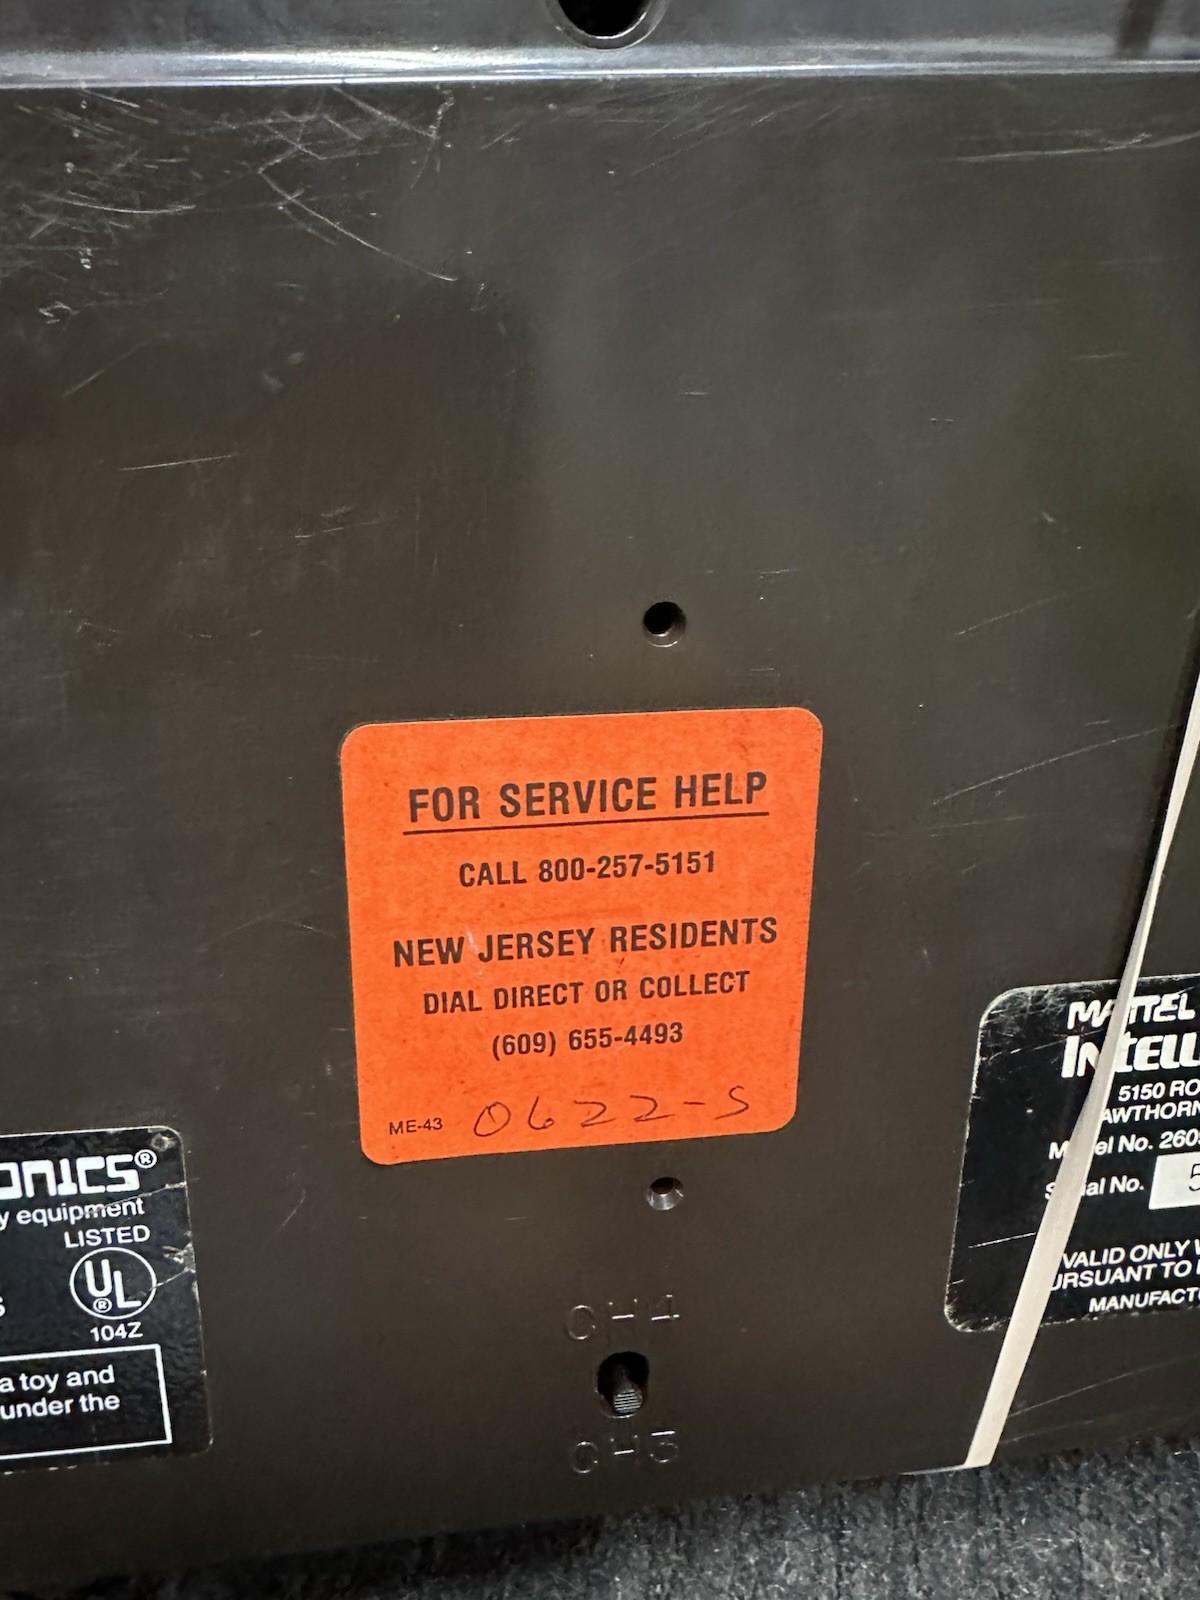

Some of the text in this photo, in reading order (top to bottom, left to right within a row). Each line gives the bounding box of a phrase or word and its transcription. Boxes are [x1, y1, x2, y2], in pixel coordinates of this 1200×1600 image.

[409, 771, 767, 823] FOR SERVICE HELP
[459, 850, 716, 887] CALL 800-257-5151
[393, 916, 778, 967] NEW JERSEY RESIDENTS
[423, 970, 750, 1014] DIAL DIRECT OR COLLECT
[492, 1021, 684, 1061] (609) 655-4493
[1118, 1081, 1166, 1101] 5150
[389, 1116, 444, 1136] ME-43
[1048, 1128, 1200, 1160] Mel No. 260
[1044, 1174, 1145, 1200] Sal No.
[15, 1197, 146, 1228] equipment
[63, 1224, 151, 1249] LISTED
[1061, 1246, 1127, 1270] VALID
[1128, 1239, 1191, 1263] ONLY
[1050, 1263, 1158, 1292] URSUANT
[1160, 1259, 1193, 1279] TO
[1088, 1286, 1200, 1313] MANUFACT
[89, 1321, 144, 1342] 104Z
[19, 1372, 60, 1395] toy
[65, 1363, 116, 1388] and
[0, 1392, 121, 1421] under the
